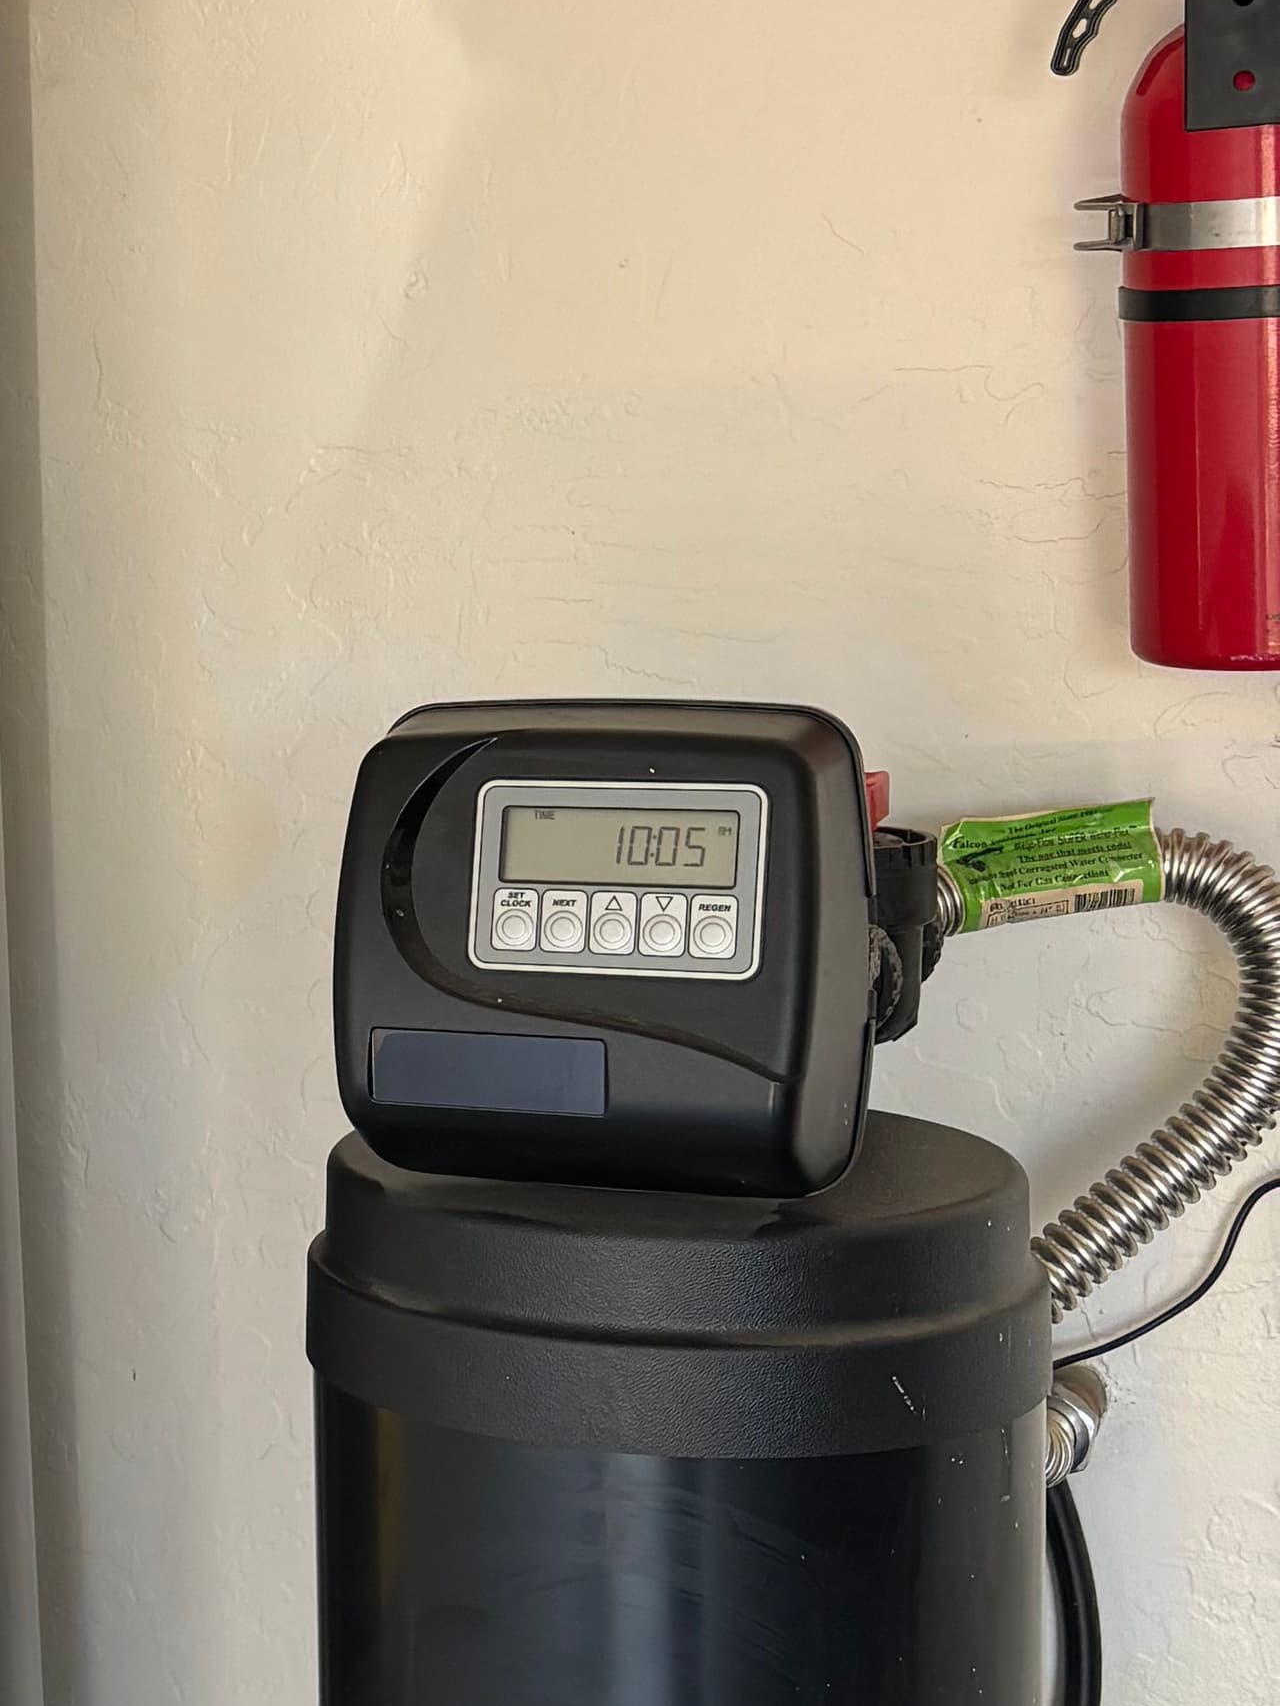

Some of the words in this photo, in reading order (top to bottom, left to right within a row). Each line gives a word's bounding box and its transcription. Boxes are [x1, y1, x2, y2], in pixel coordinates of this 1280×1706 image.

[534, 809, 555, 820] TIME
[616, 825, 706, 867] 10:05
[1069, 858, 1096, 867] Water
[508, 891, 526, 899] SET
[500, 899, 532, 908] CLOCK
[552, 899, 577, 908] NEXT
[698, 903, 732, 912] REGEN
